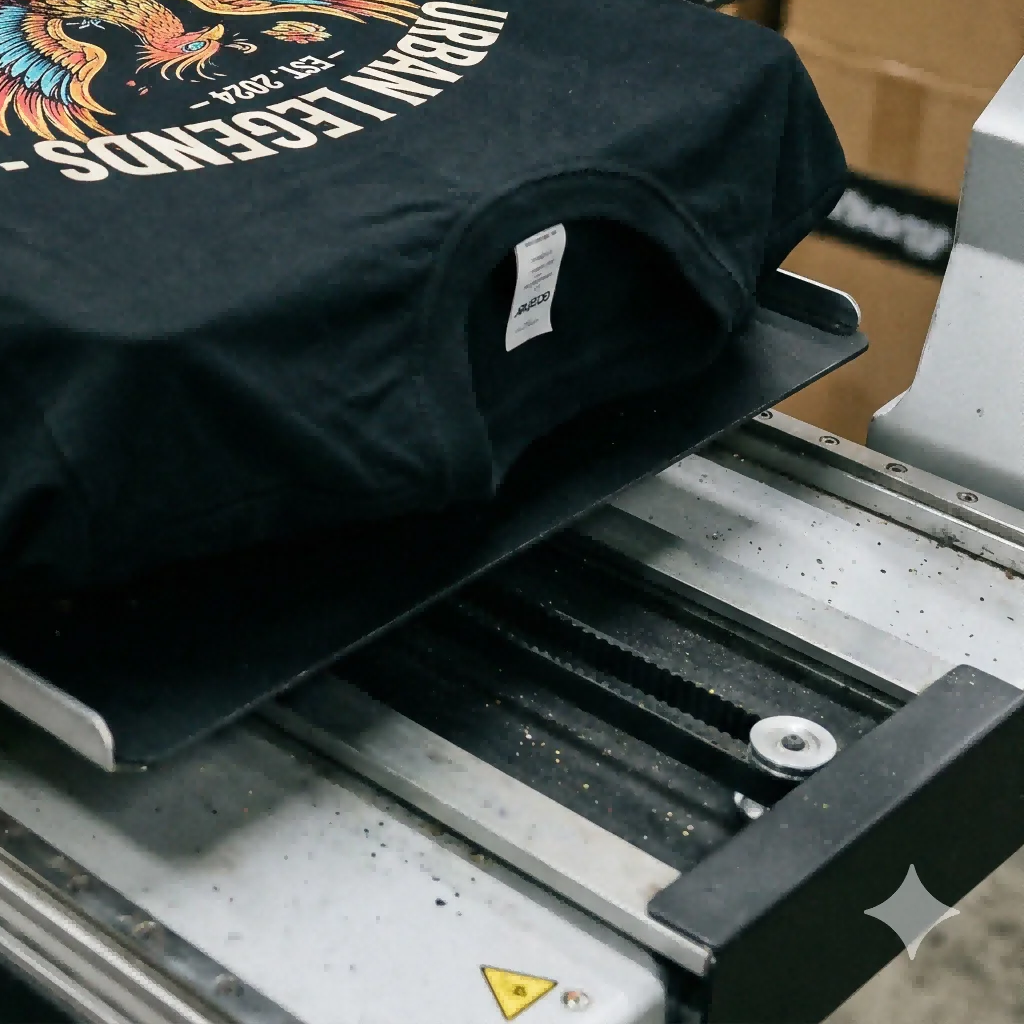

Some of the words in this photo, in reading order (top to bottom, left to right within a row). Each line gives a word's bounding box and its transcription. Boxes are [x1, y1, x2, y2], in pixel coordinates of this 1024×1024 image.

[208, 73, 284, 105] 2024
[340, 1, 509, 107] URBAN
[33, 86, 398, 182] LEGENDS
